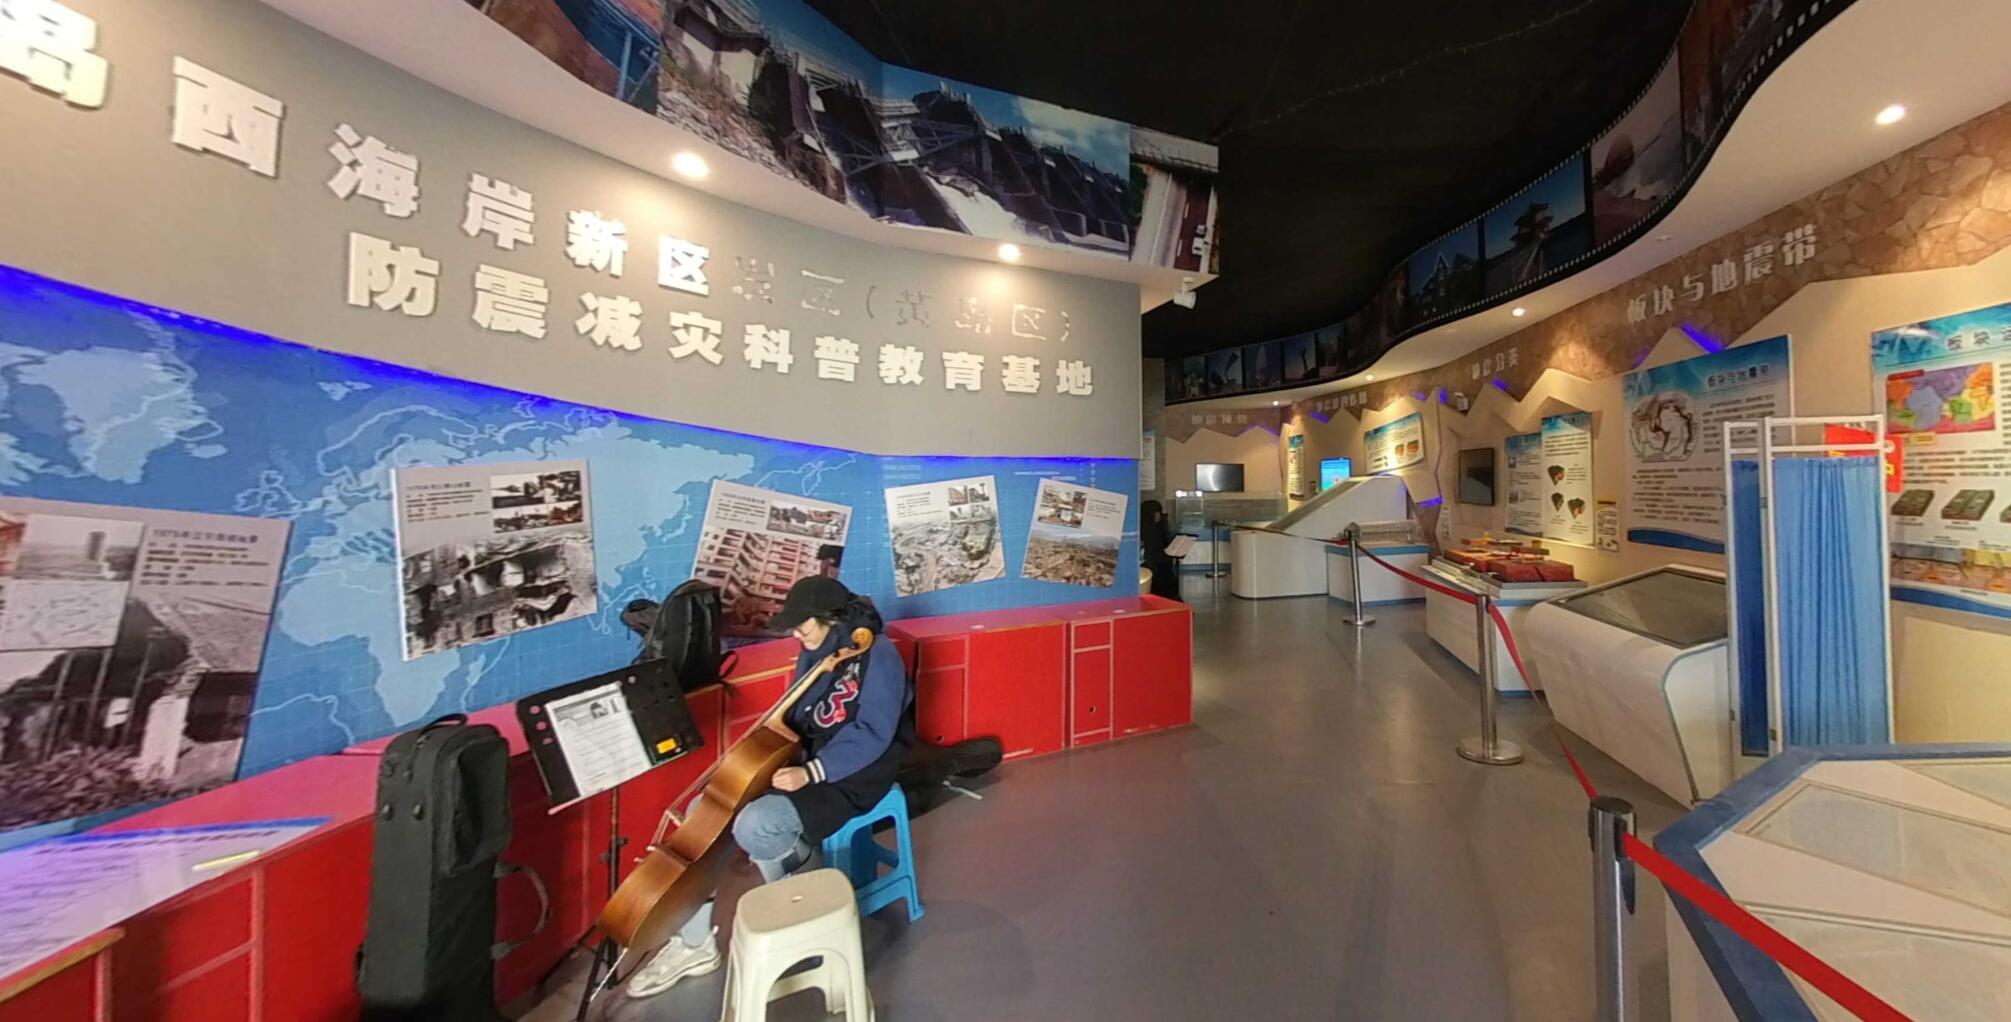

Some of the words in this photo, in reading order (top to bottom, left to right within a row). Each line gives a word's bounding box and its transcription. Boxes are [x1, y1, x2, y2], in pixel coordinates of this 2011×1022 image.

[347, 231, 1093, 396] 防震减灾科普教育基地
[1626, 223, 1817, 324] 板块与地震带
